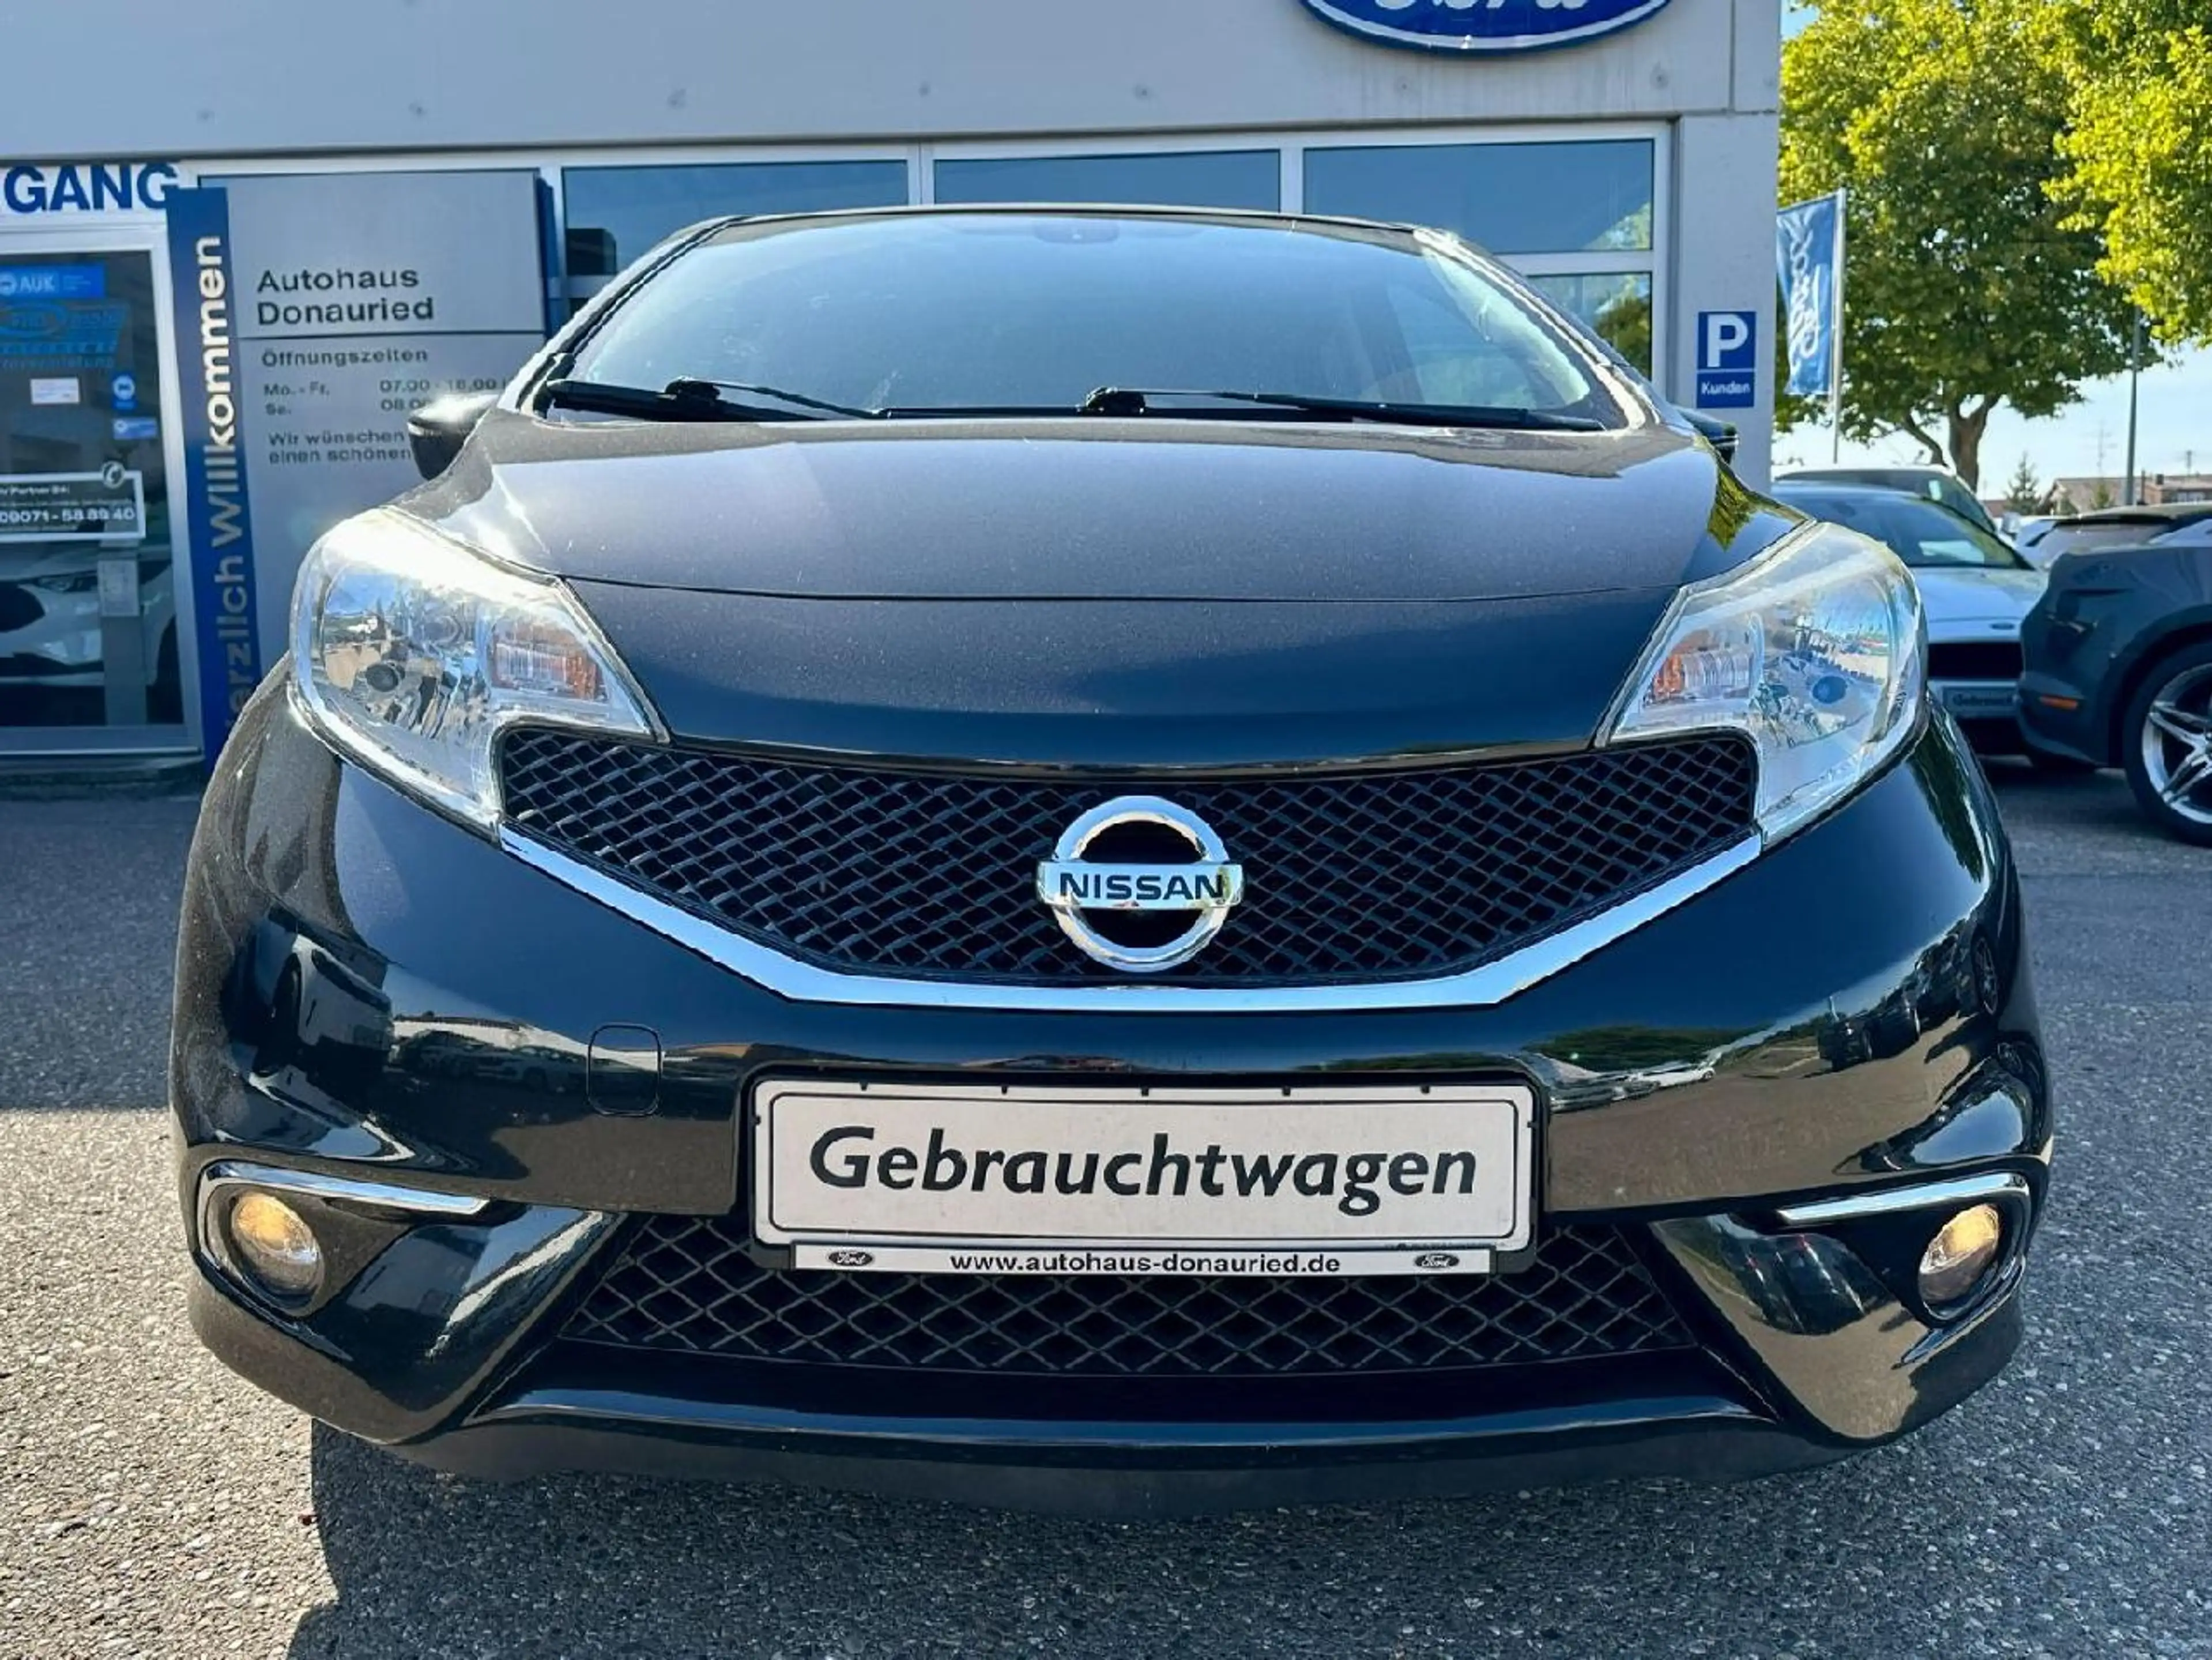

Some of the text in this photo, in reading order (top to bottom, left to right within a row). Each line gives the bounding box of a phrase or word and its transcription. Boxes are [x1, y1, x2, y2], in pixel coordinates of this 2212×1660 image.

[4, 163, 179, 213] GANG
[257, 269, 420, 292] Autohaus
[257, 296, 434, 326] Donauried
[1707, 314, 1749, 367] P
[262, 347, 428, 367] Öffnungszeiten
[1702, 380, 1751, 394] Kunden
[267, 429, 405, 446] Wir wünschen
[269, 447, 412, 465] einen schönen
[196, 235, 254, 727] erzlich Willkommen
[1060, 873, 1223, 900] NISSAN
[810, 1126, 1476, 1216] Gebrauchtwagen
[951, 1252, 1340, 1273] www.autohaus-donauried.de
